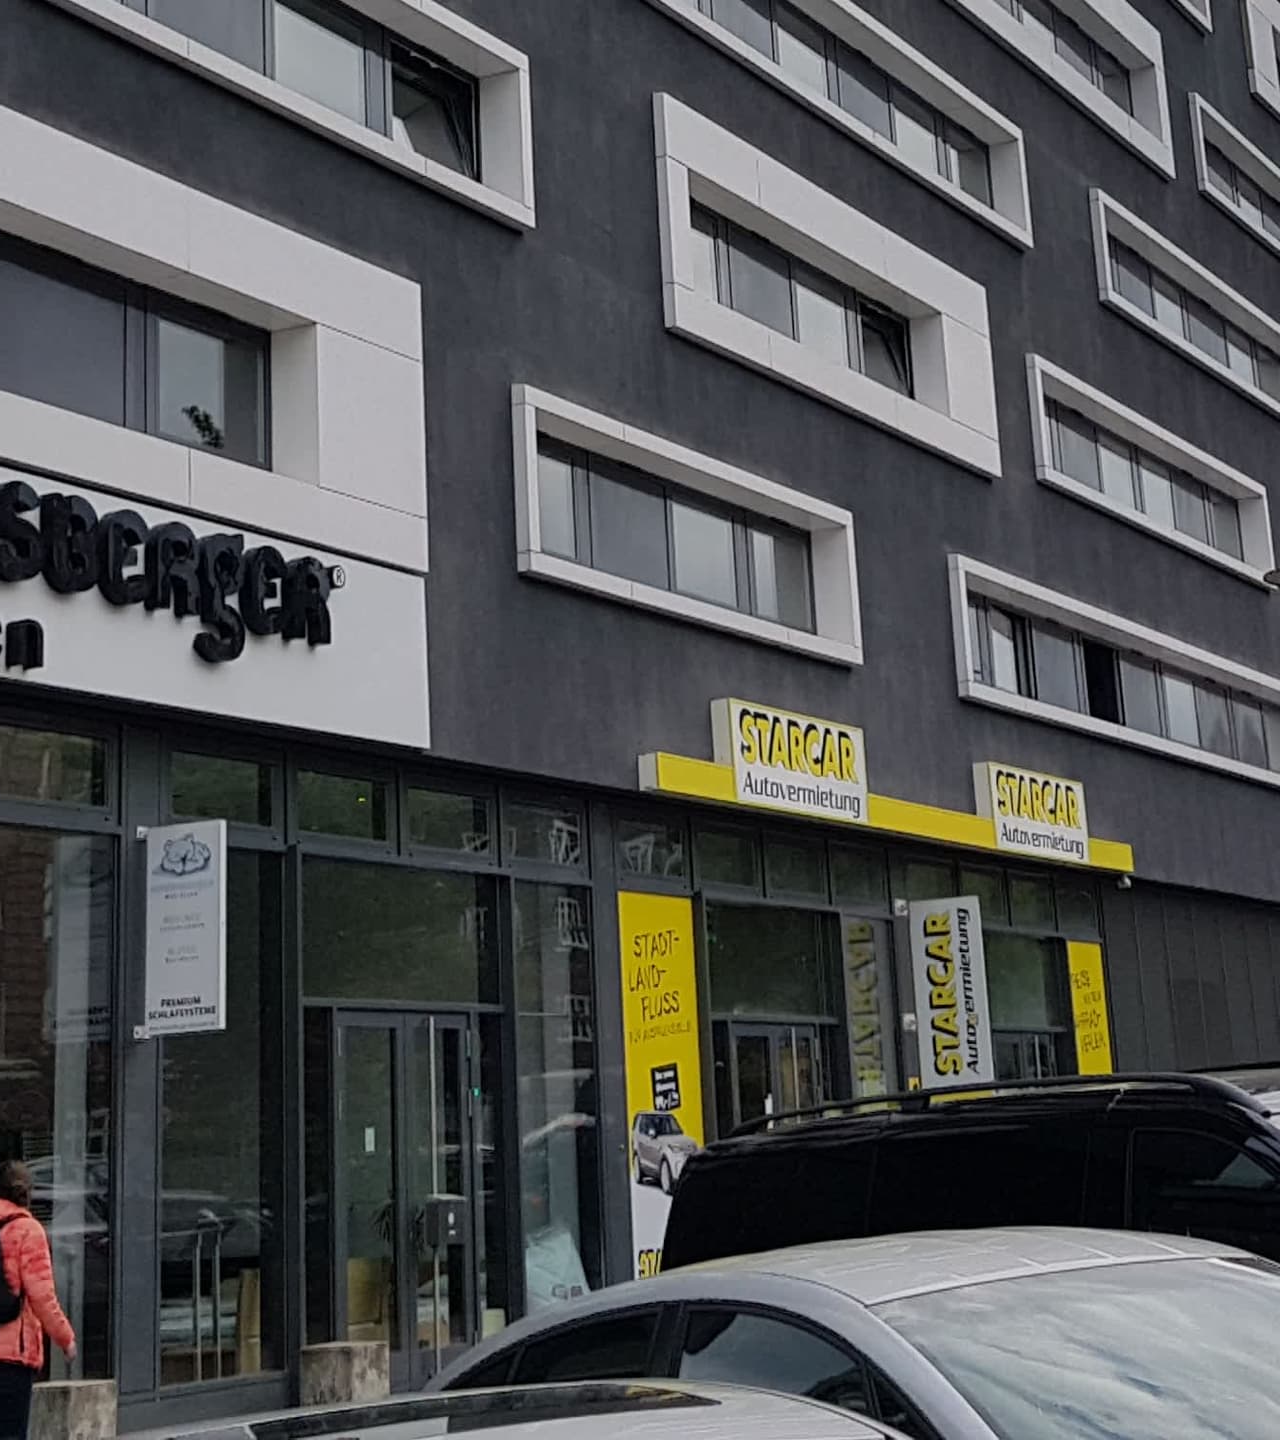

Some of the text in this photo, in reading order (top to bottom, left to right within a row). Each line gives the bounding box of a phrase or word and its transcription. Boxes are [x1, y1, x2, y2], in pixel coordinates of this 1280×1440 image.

[739, 708, 860, 785] STARCAR
[743, 771, 861, 819] Autovermietung
[996, 769, 1082, 830] STARCAR
[1001, 822, 1085, 860] Autovermietung
[633, 929, 681, 959] STADT-
[628, 964, 667, 993] LAND-
[924, 911, 963, 1076] STARCAR
[161, 995, 201, 1008] PREMIUM
[640, 991, 681, 1023] FLUSS
